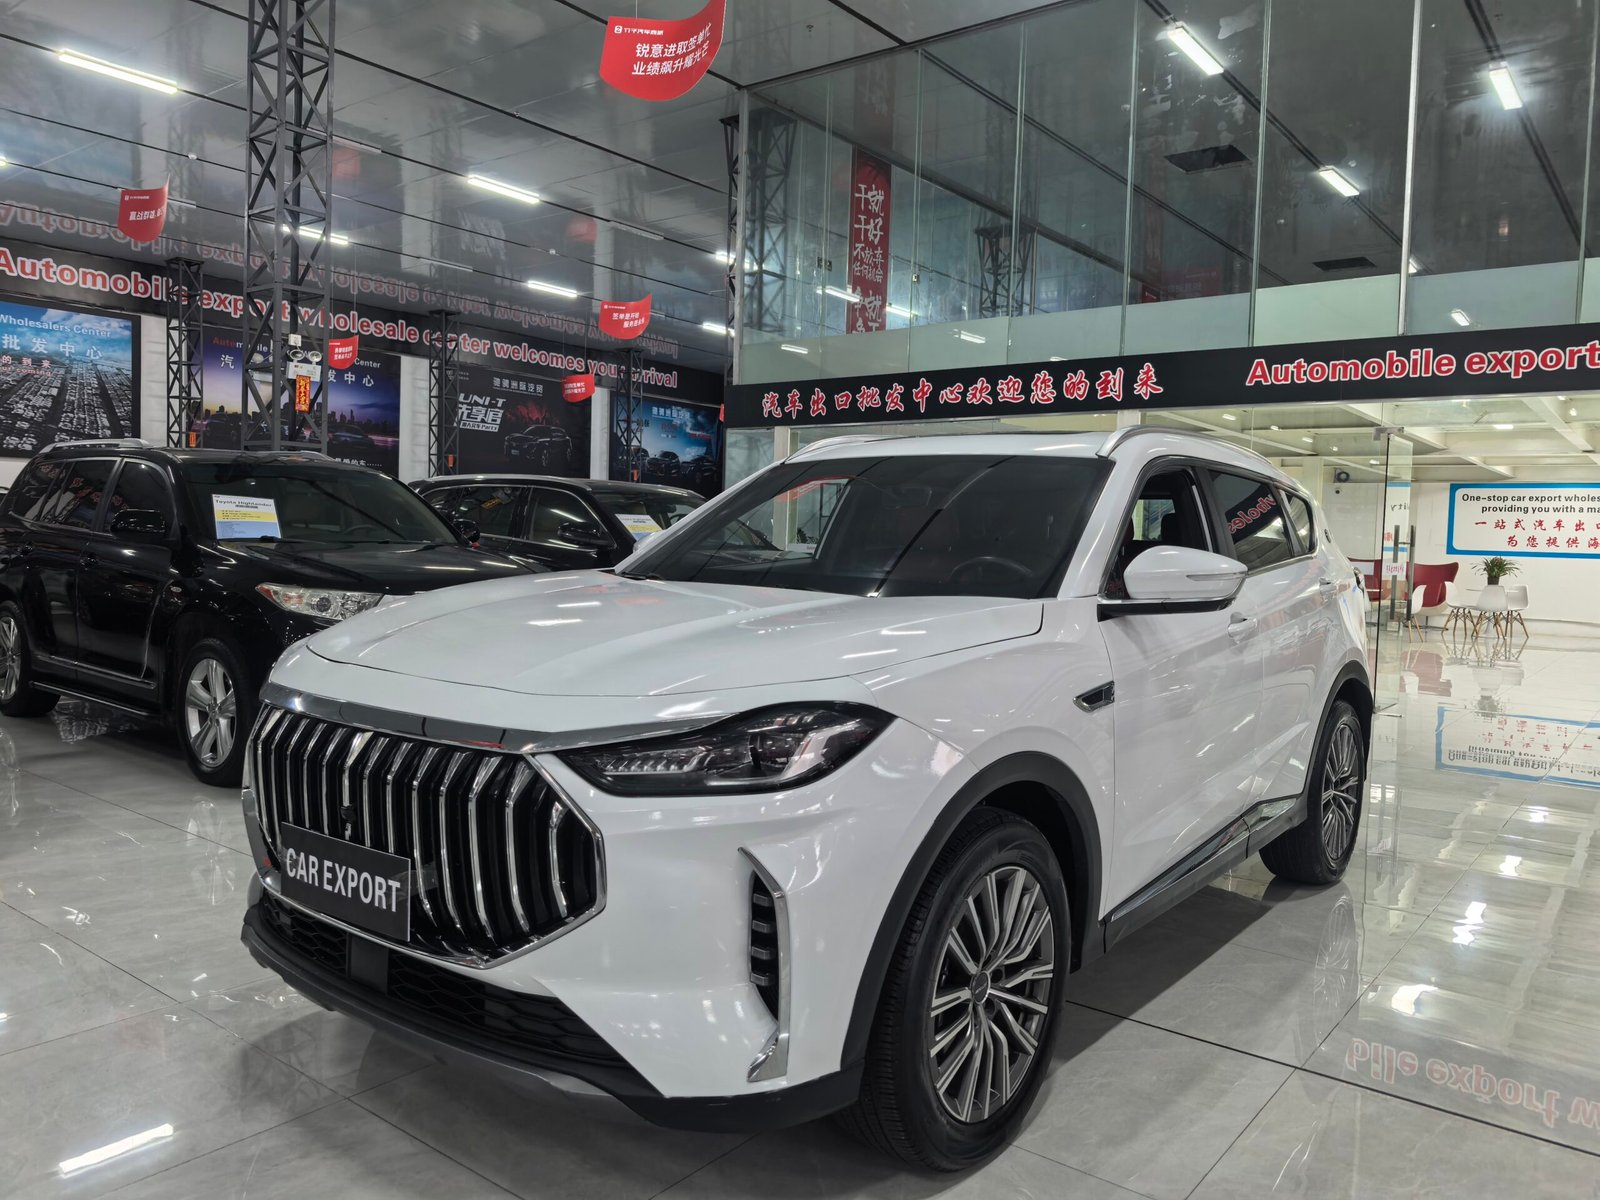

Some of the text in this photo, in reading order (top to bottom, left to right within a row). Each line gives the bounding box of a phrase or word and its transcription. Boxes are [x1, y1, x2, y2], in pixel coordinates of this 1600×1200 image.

[0, 313, 112, 338] Wholesalers Center
[196, 289, 291, 322] expot
[493, 341, 584, 373] welcomes
[1, 333, 104, 360] 批发中心
[354, 357, 382, 369] Center
[1246, 340, 1600, 386] Automobile export
[459, 392, 507, 407] UNI-T
[761, 362, 1164, 420] 汽车出口批发中心欢迎您的到来
[1461, 493, 1509, 503] One-stop
[1511, 494, 1527, 502] car
[1528, 493, 1562, 503] export
[1481, 504, 1529, 514] providing
[1531, 505, 1550, 514] you
[1552, 504, 1576, 513] with
[1578, 505, 1584, 513] a
[286, 847, 401, 913] CAR EXPORT
